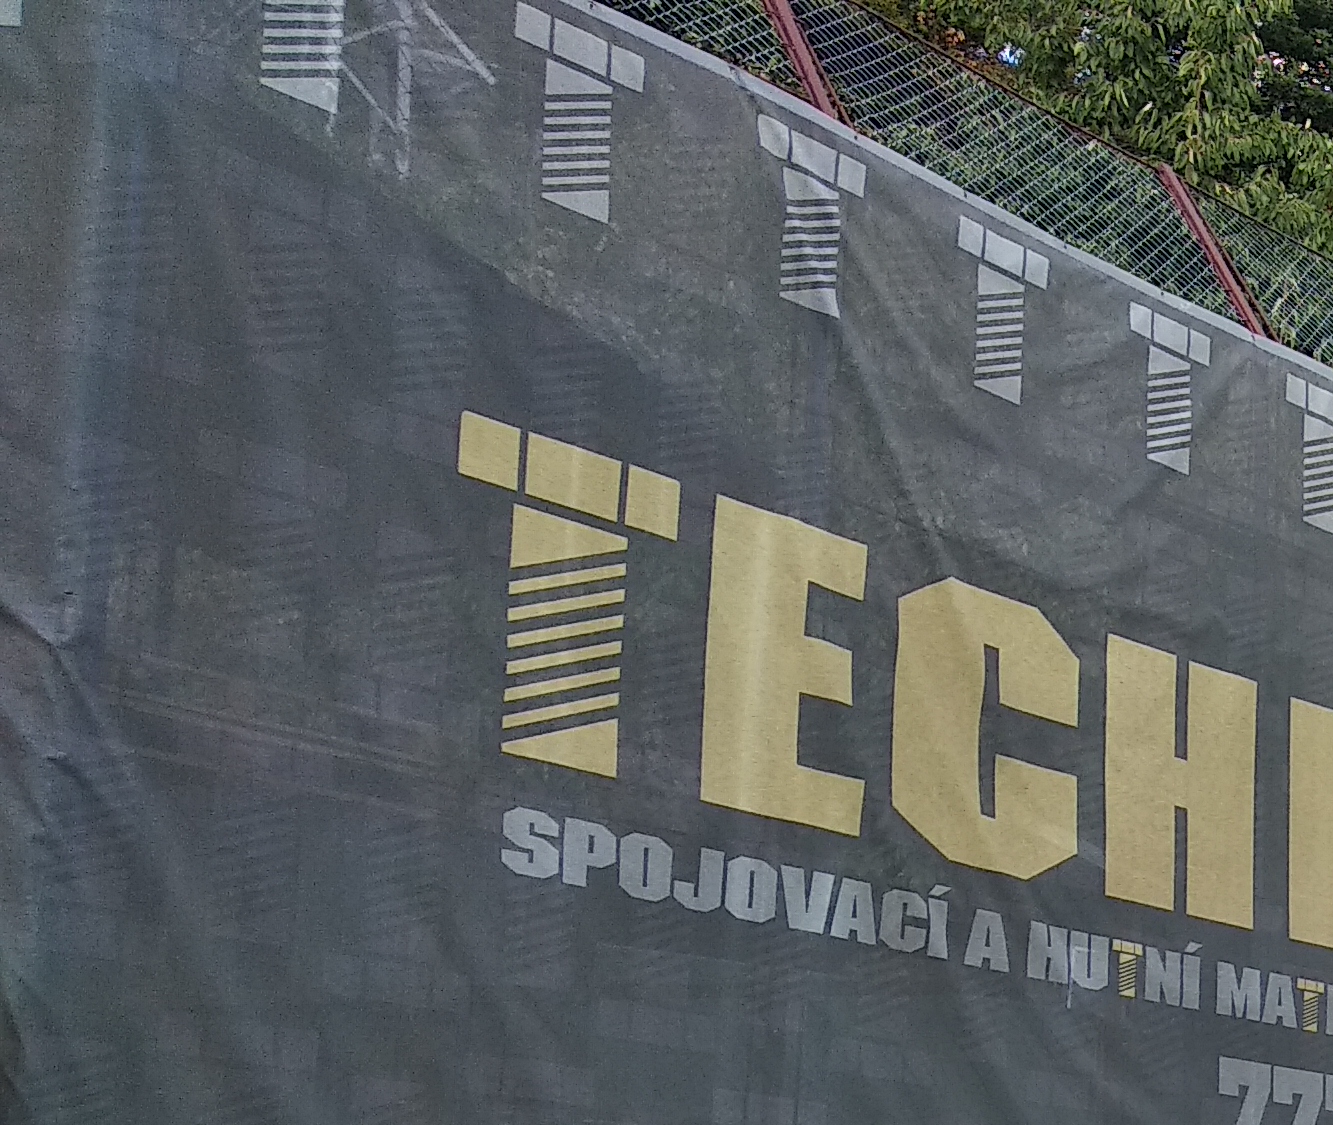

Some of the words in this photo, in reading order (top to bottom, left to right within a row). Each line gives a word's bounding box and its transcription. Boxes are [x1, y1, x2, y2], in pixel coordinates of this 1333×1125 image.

[501, 806, 951, 960] SPOJOVACÍ
[964, 908, 1010, 972] A
[1027, 919, 1202, 1010] HUTNÍ
